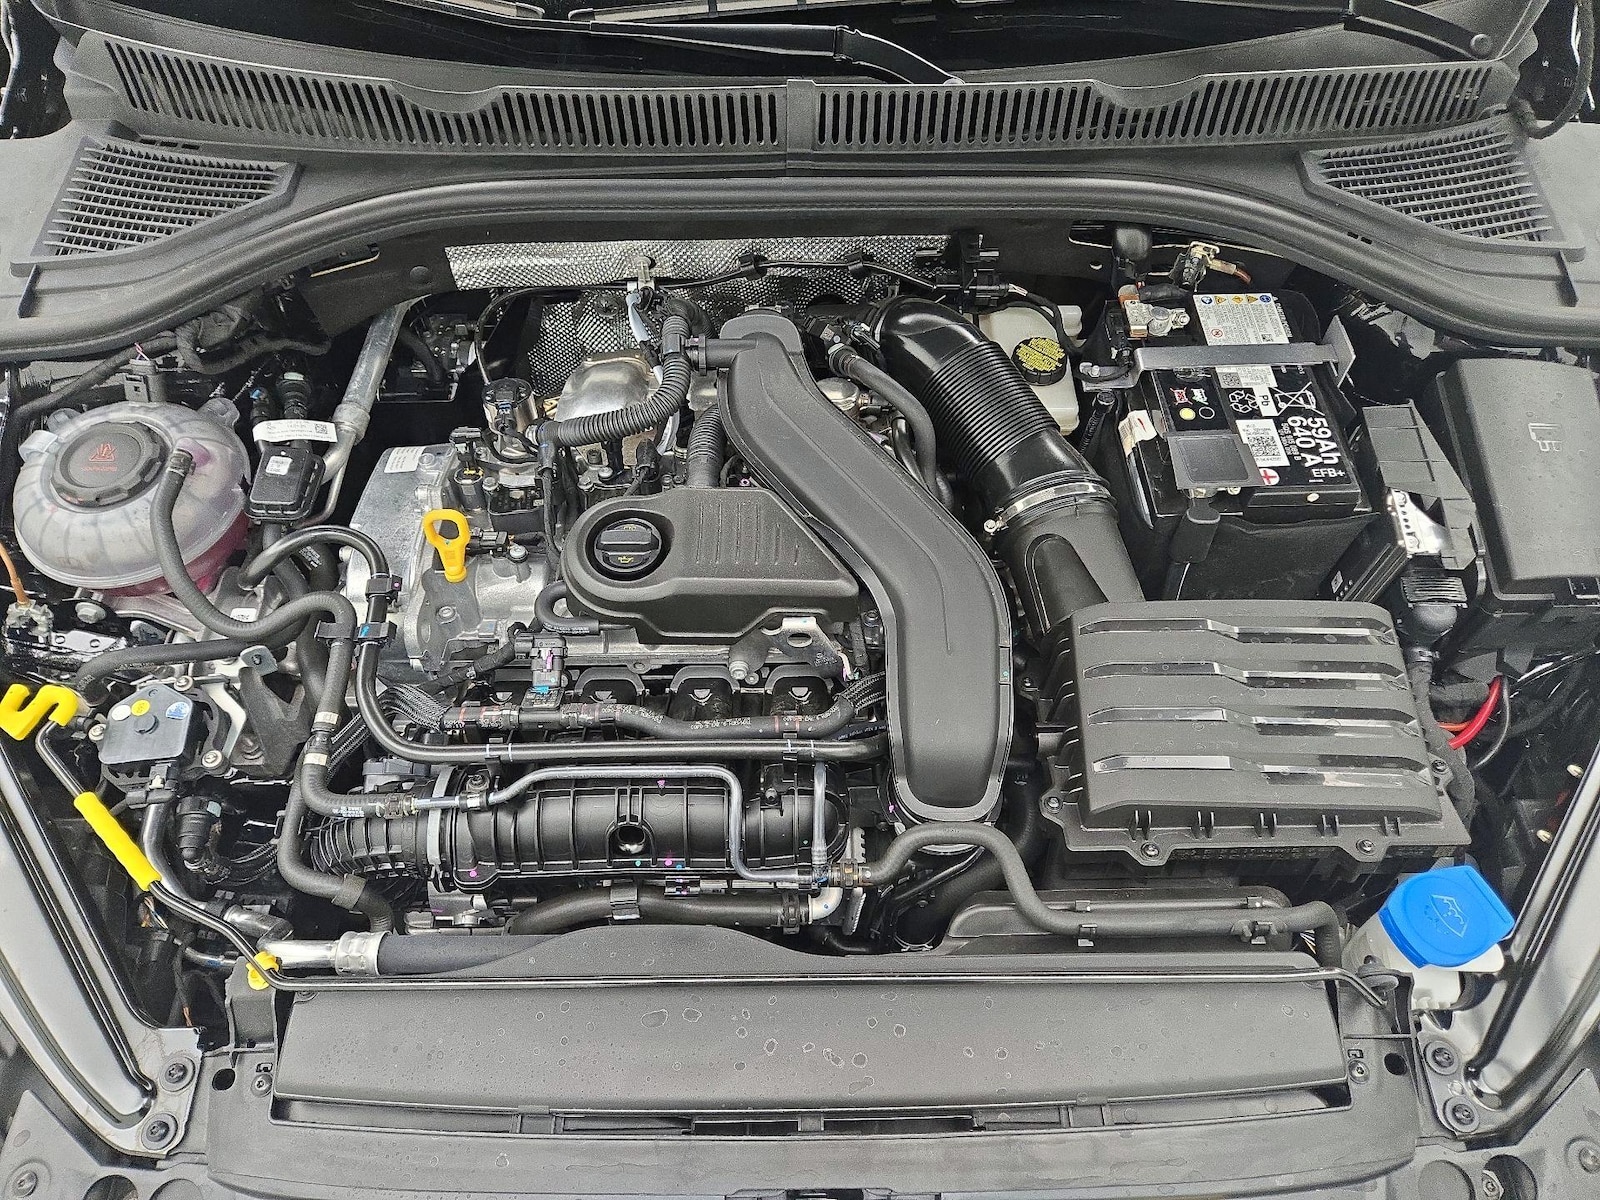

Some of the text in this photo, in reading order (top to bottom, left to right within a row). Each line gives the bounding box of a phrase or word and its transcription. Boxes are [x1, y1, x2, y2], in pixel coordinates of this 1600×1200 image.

[1259, 394, 1270, 406] Pb
[1287, 416, 1323, 467] 640 A
[1308, 417, 1341, 465] 59Ah
[1312, 468, 1346, 478] EFB+
